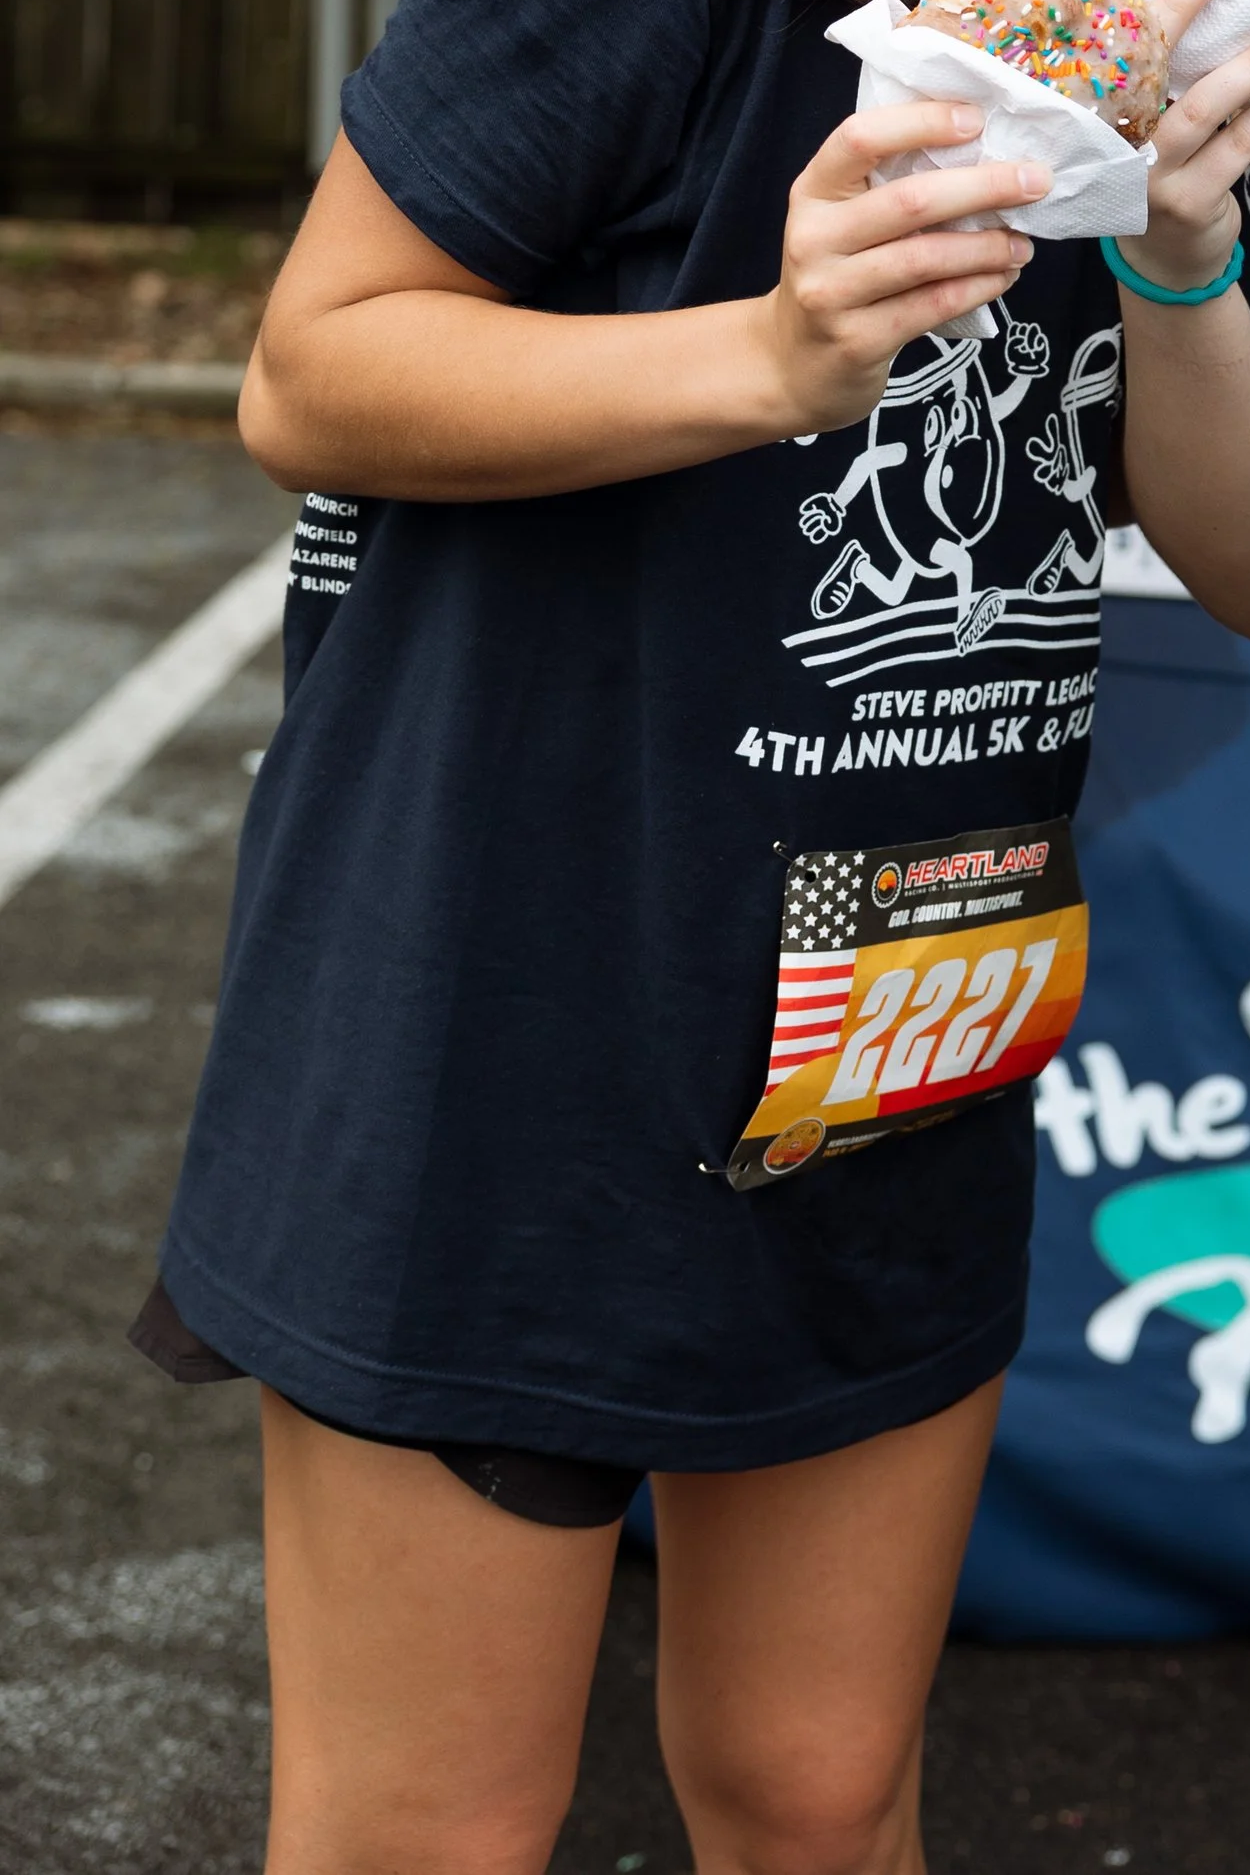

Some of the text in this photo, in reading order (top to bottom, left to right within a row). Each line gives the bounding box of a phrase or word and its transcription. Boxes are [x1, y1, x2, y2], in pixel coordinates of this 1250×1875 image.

[305, 491, 359, 518] CHURCH
[851, 689, 927, 722] STEVE
[932, 679, 1043, 717] PROFFITT
[734, 702, 1096, 776] 4TH ANNUAL 5K & FU
[903, 841, 1049, 889] HEARTLAND
